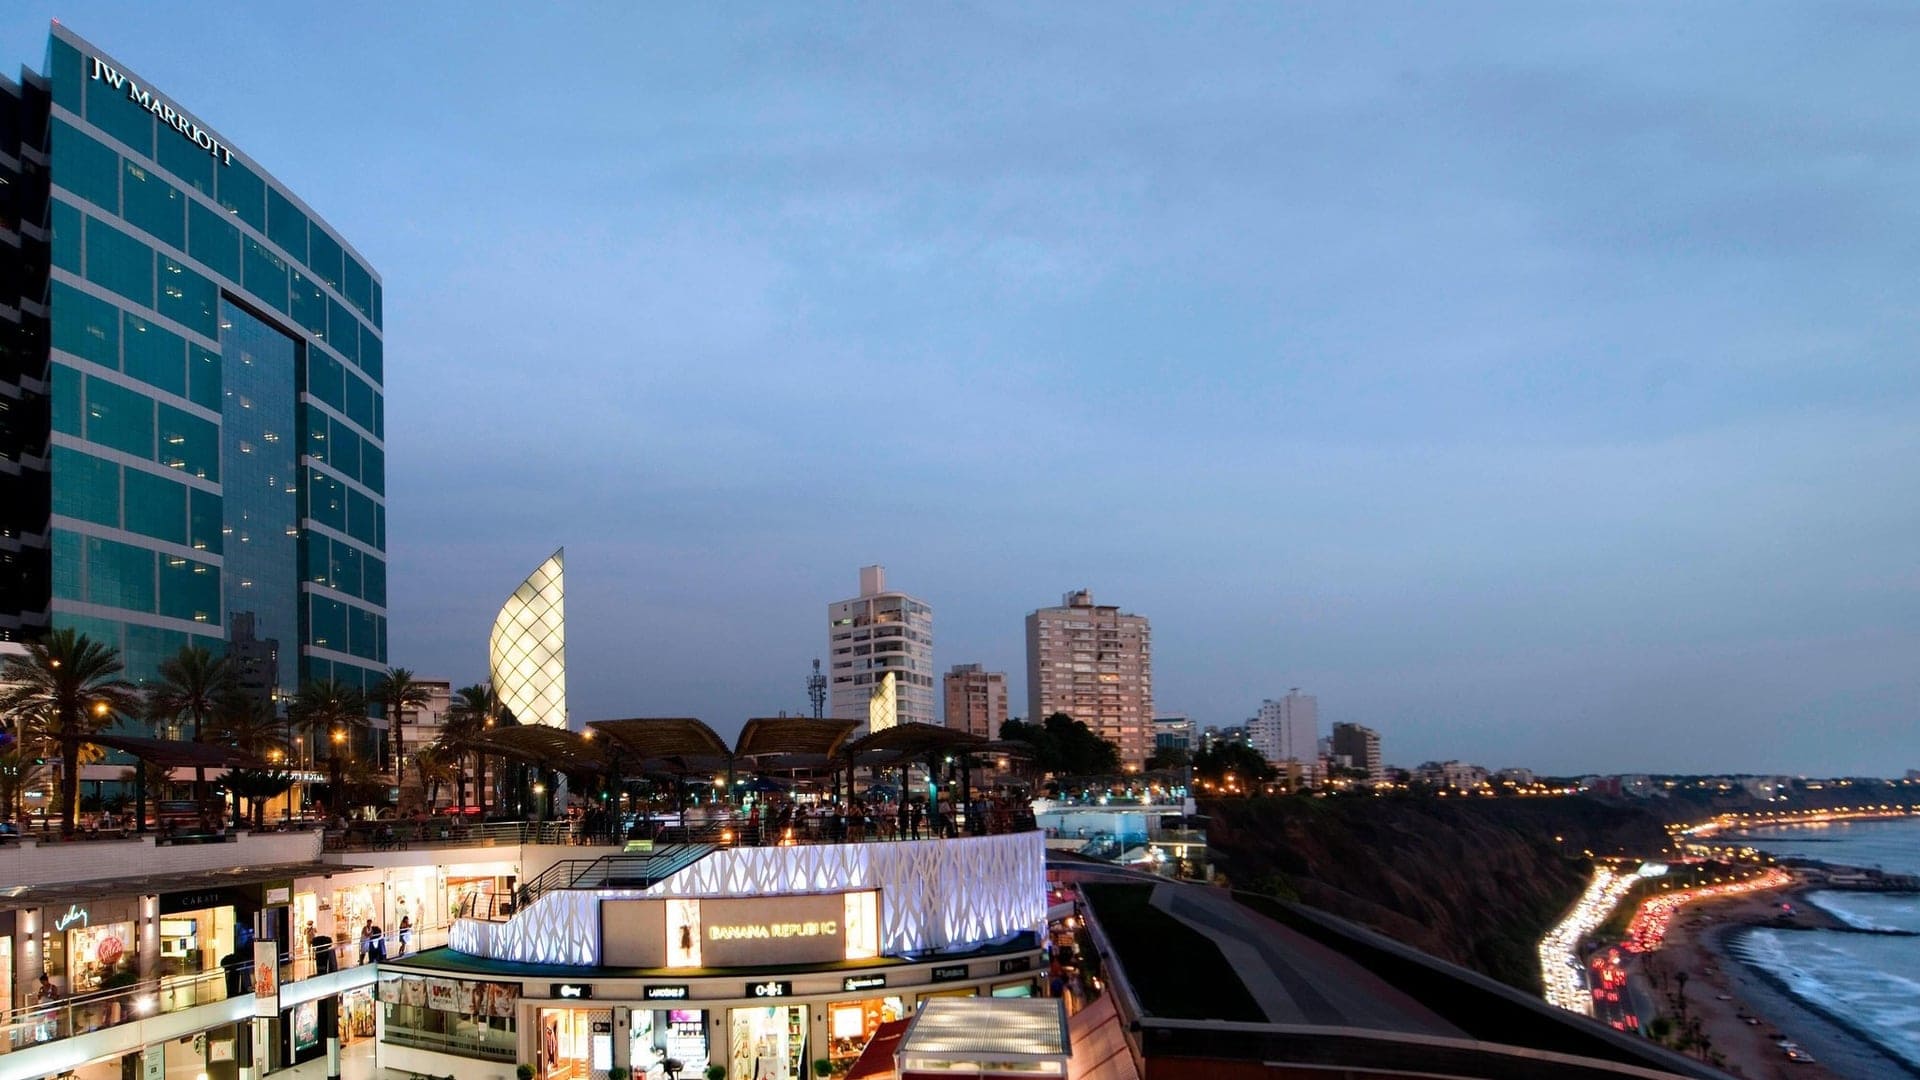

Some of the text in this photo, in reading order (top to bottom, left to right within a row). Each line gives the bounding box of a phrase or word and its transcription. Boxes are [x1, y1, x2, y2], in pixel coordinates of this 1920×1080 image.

[91, 56, 234, 166] JW MARRIOTT
[709, 921, 837, 940] BANANA REPUBLIC
